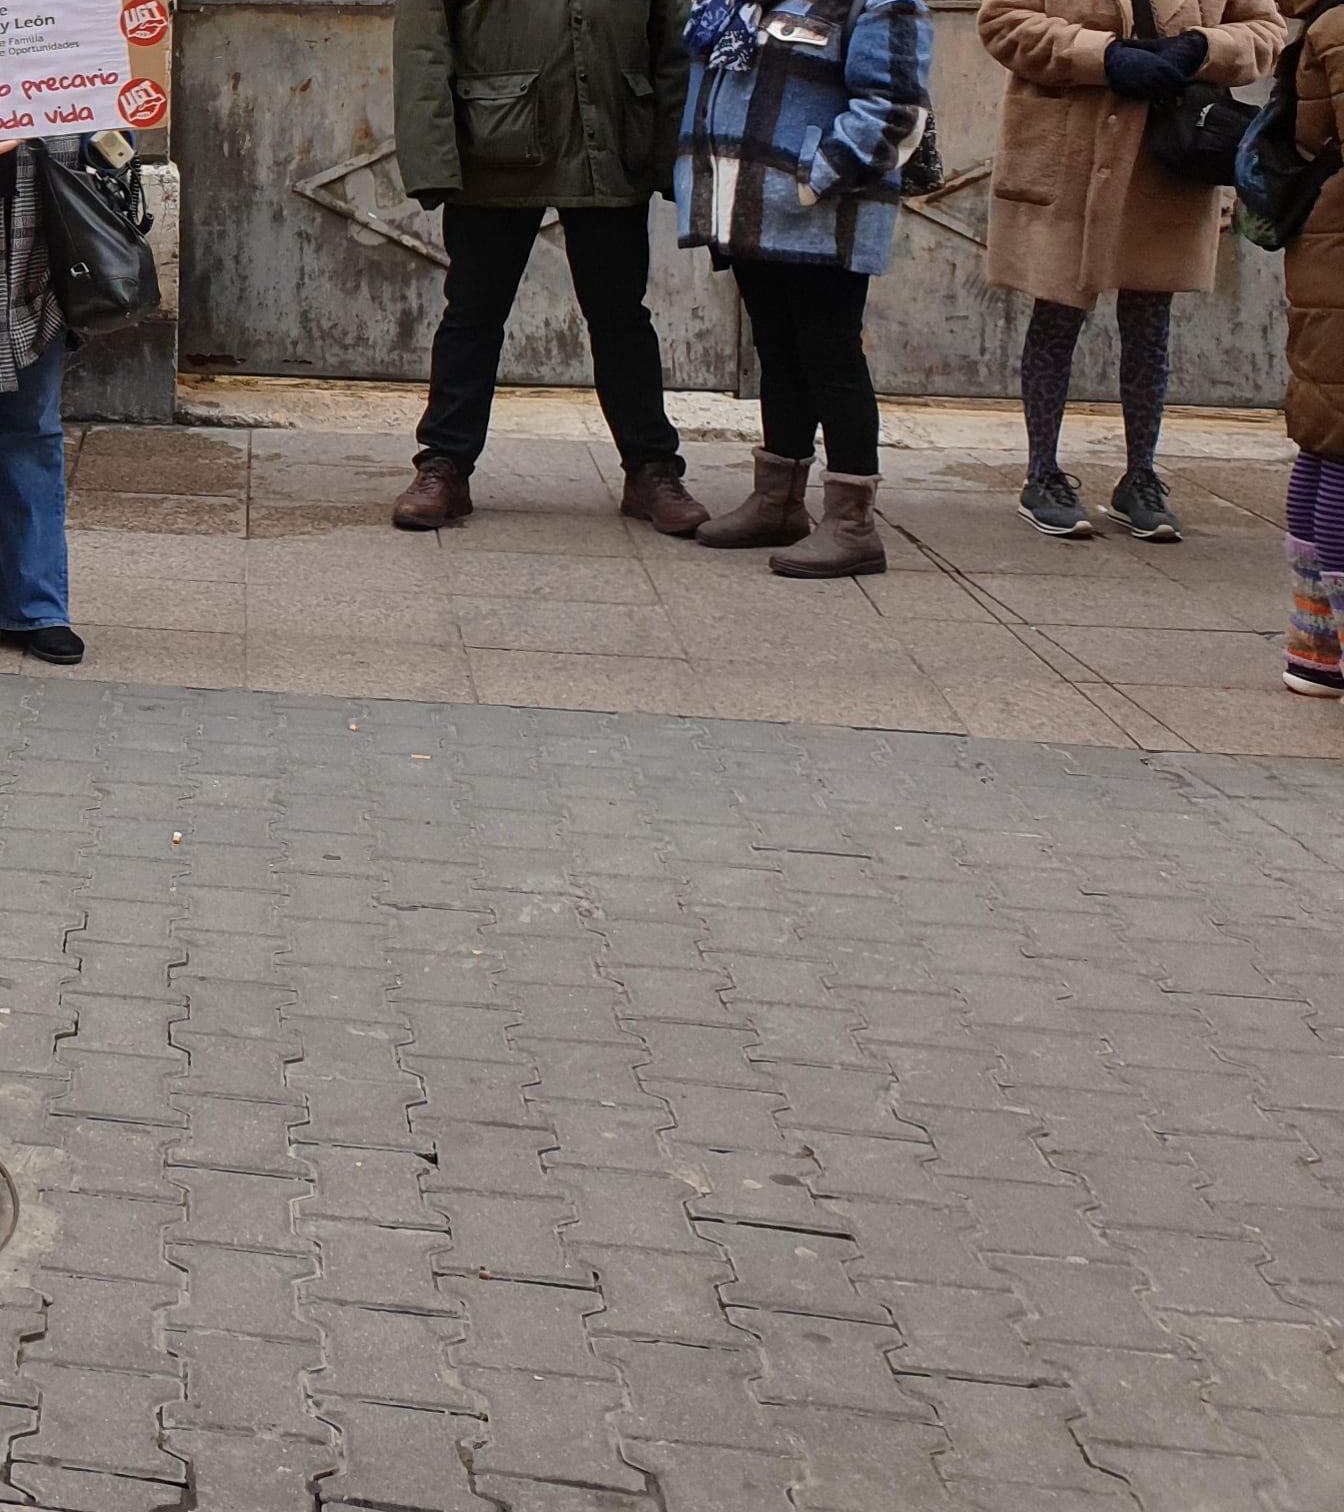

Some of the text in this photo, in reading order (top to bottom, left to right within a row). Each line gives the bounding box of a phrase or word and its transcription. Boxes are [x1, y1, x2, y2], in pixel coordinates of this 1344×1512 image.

[0, 21, 10, 34] y
[14, 15, 55, 29] León
[8, 34, 44, 46] Familia
[8, 41, 80, 56] Oportunidades
[20, 68, 118, 100] precario
[44, 103, 95, 124] vida
